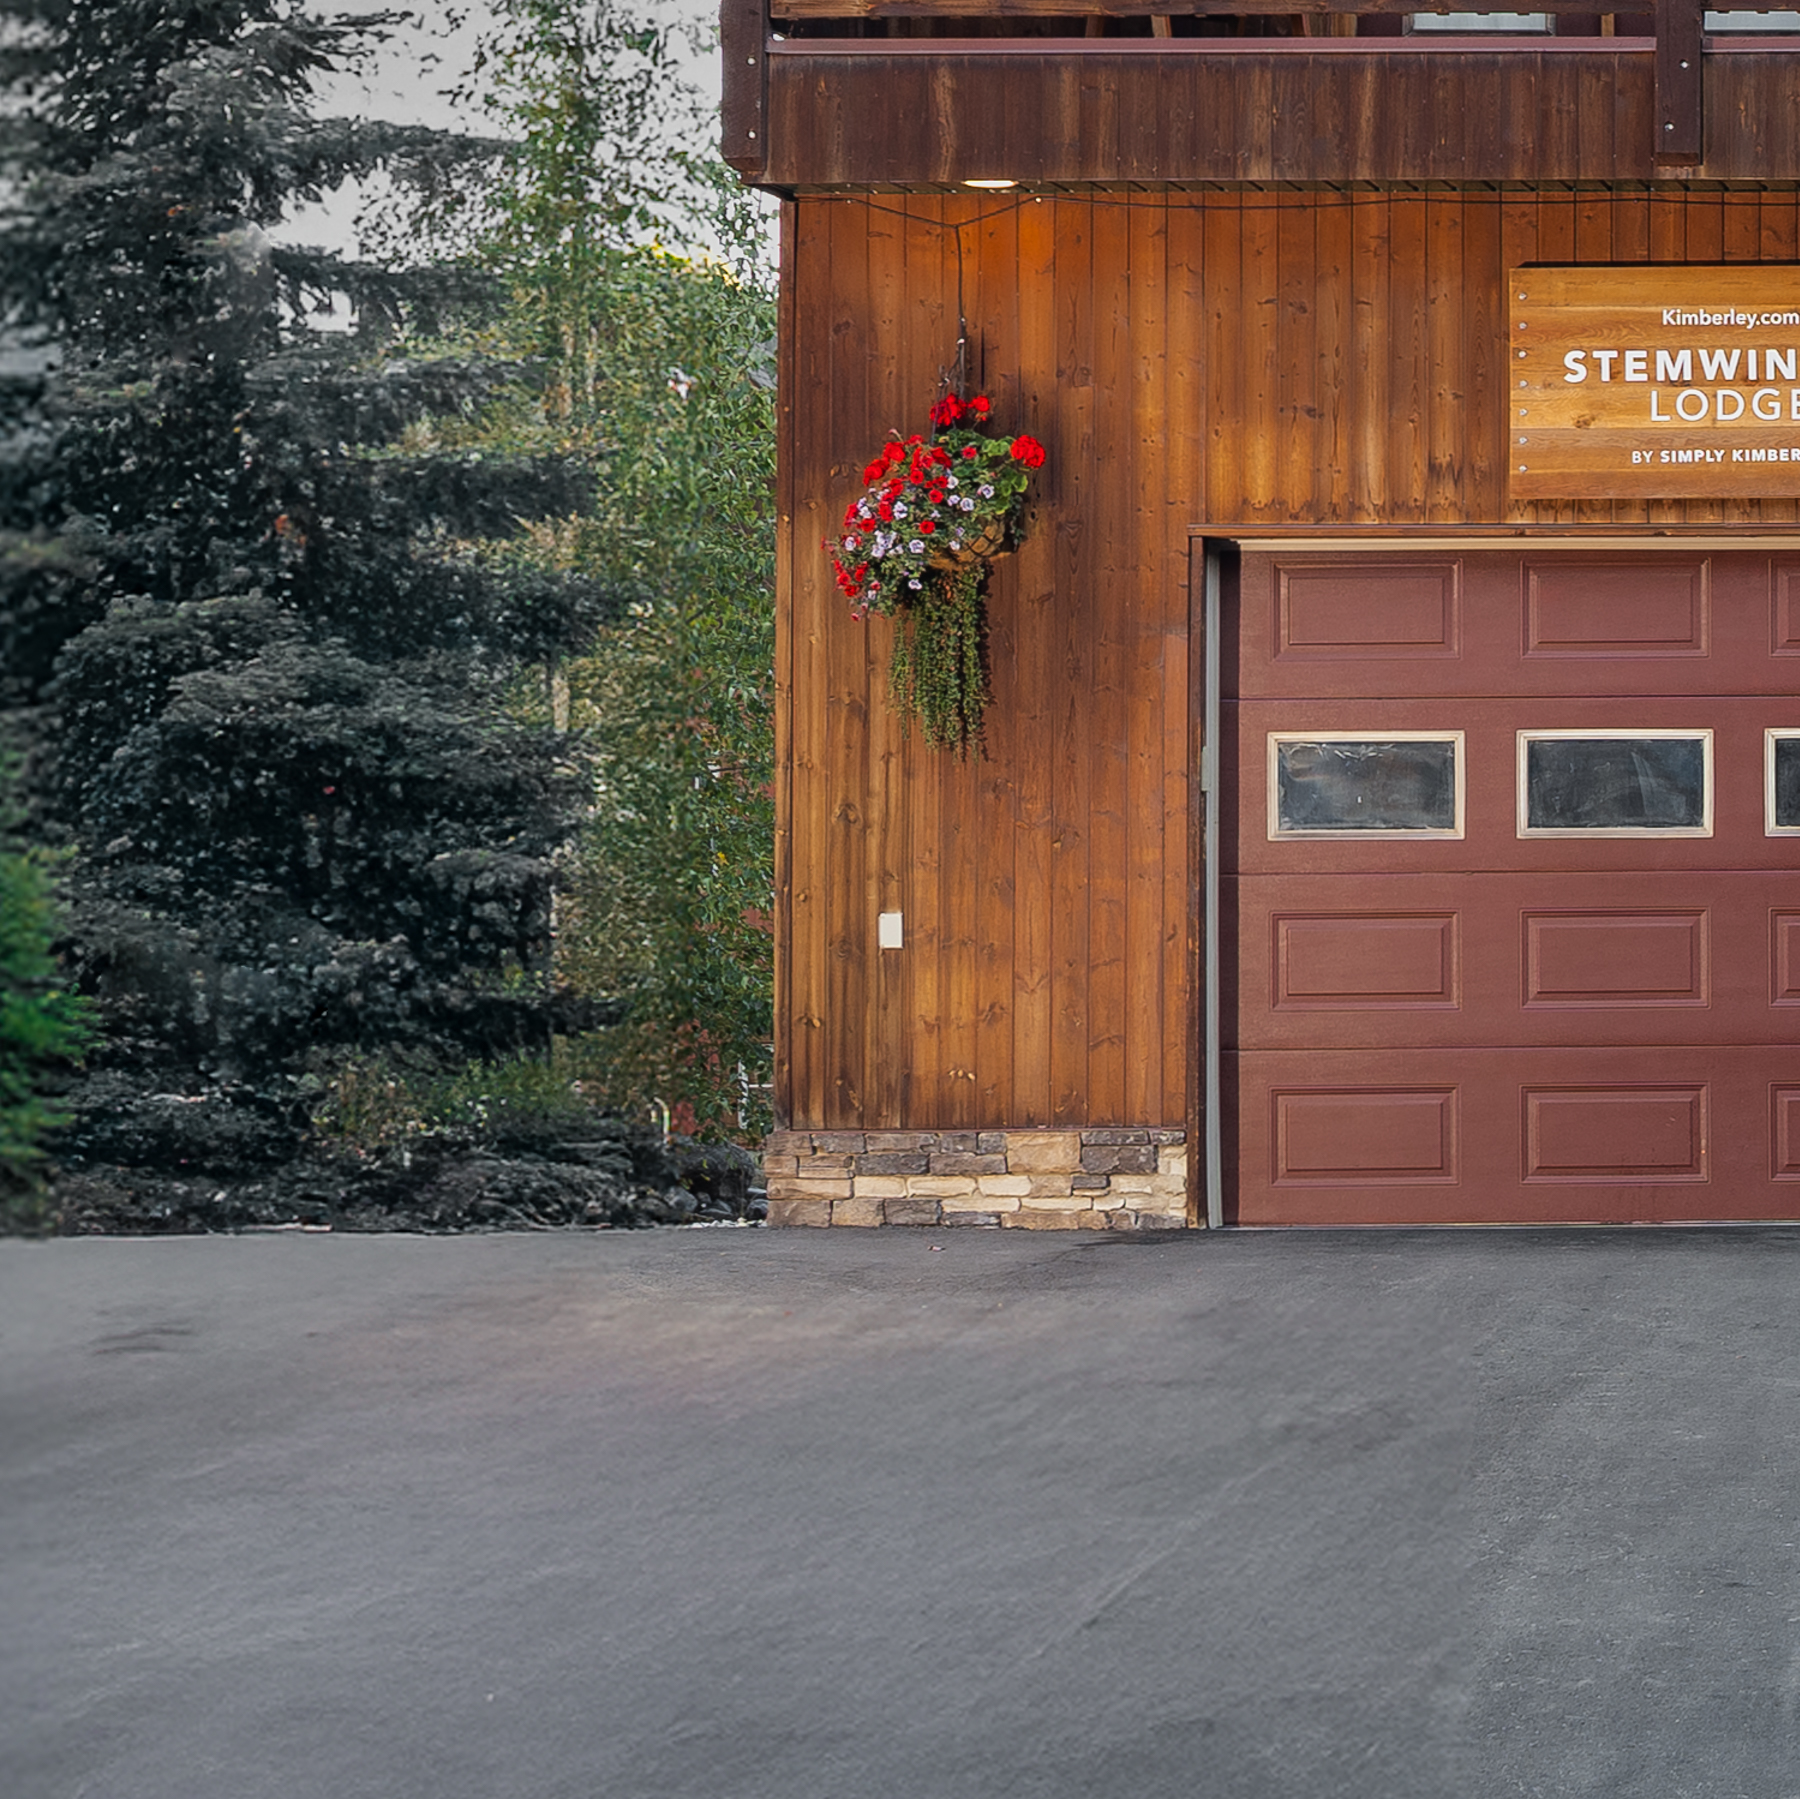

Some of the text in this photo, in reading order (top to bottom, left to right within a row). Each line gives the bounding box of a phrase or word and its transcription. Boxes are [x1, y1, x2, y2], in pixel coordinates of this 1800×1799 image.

[1661, 309, 1800, 329] Kimberley.com
[1631, 451, 1654, 464] BY
[1660, 450, 1726, 463] SIMPLY
